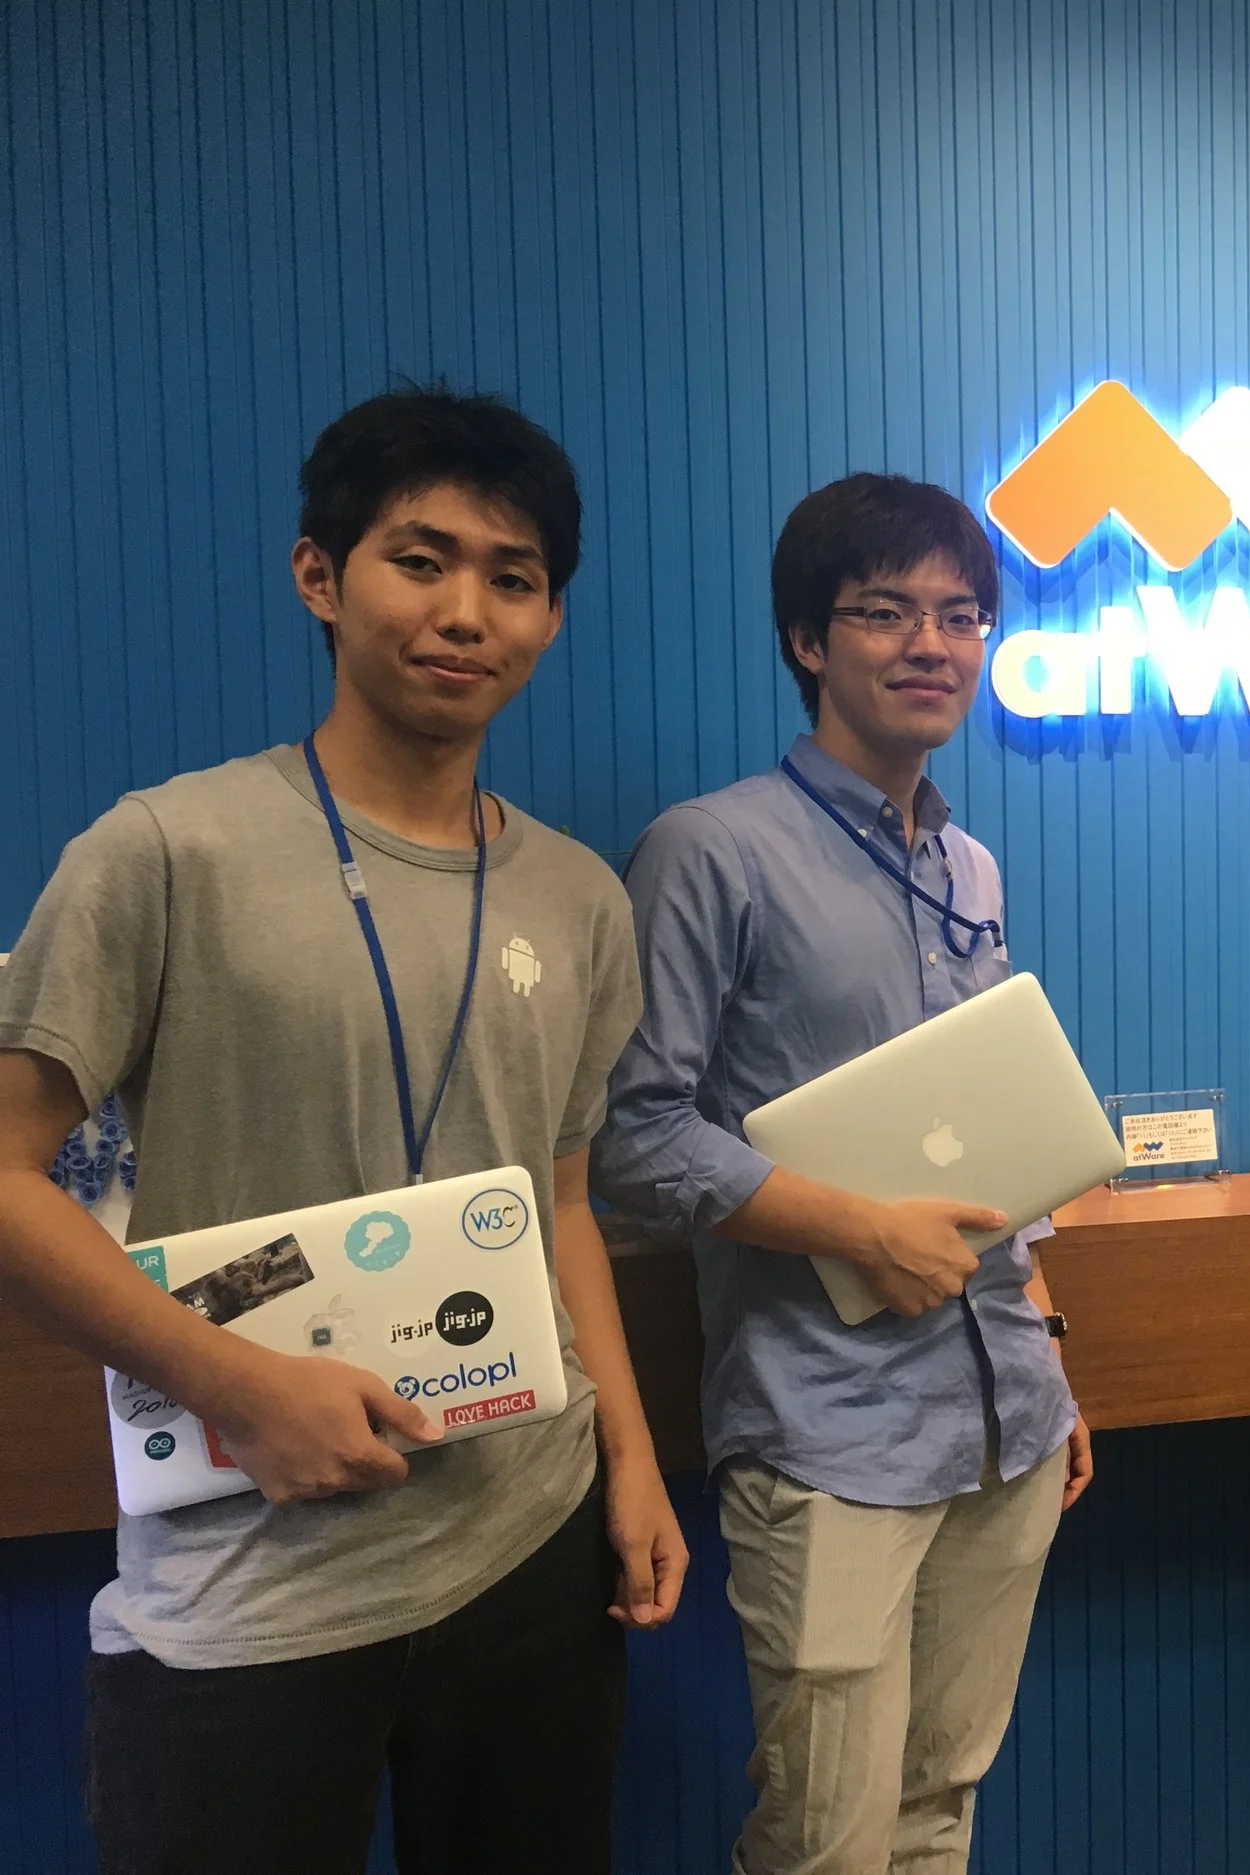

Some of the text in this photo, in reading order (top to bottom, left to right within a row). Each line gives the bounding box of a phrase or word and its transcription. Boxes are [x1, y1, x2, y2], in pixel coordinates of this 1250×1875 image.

[1133, 1152, 1165, 1162] atWare
[470, 1206, 516, 1232] W3C
[390, 1319, 434, 1344] jig.jp
[443, 1308, 487, 1332] jig.jp
[422, 1351, 517, 1397] colopl
[447, 1393, 532, 1428] LOVE HACK
